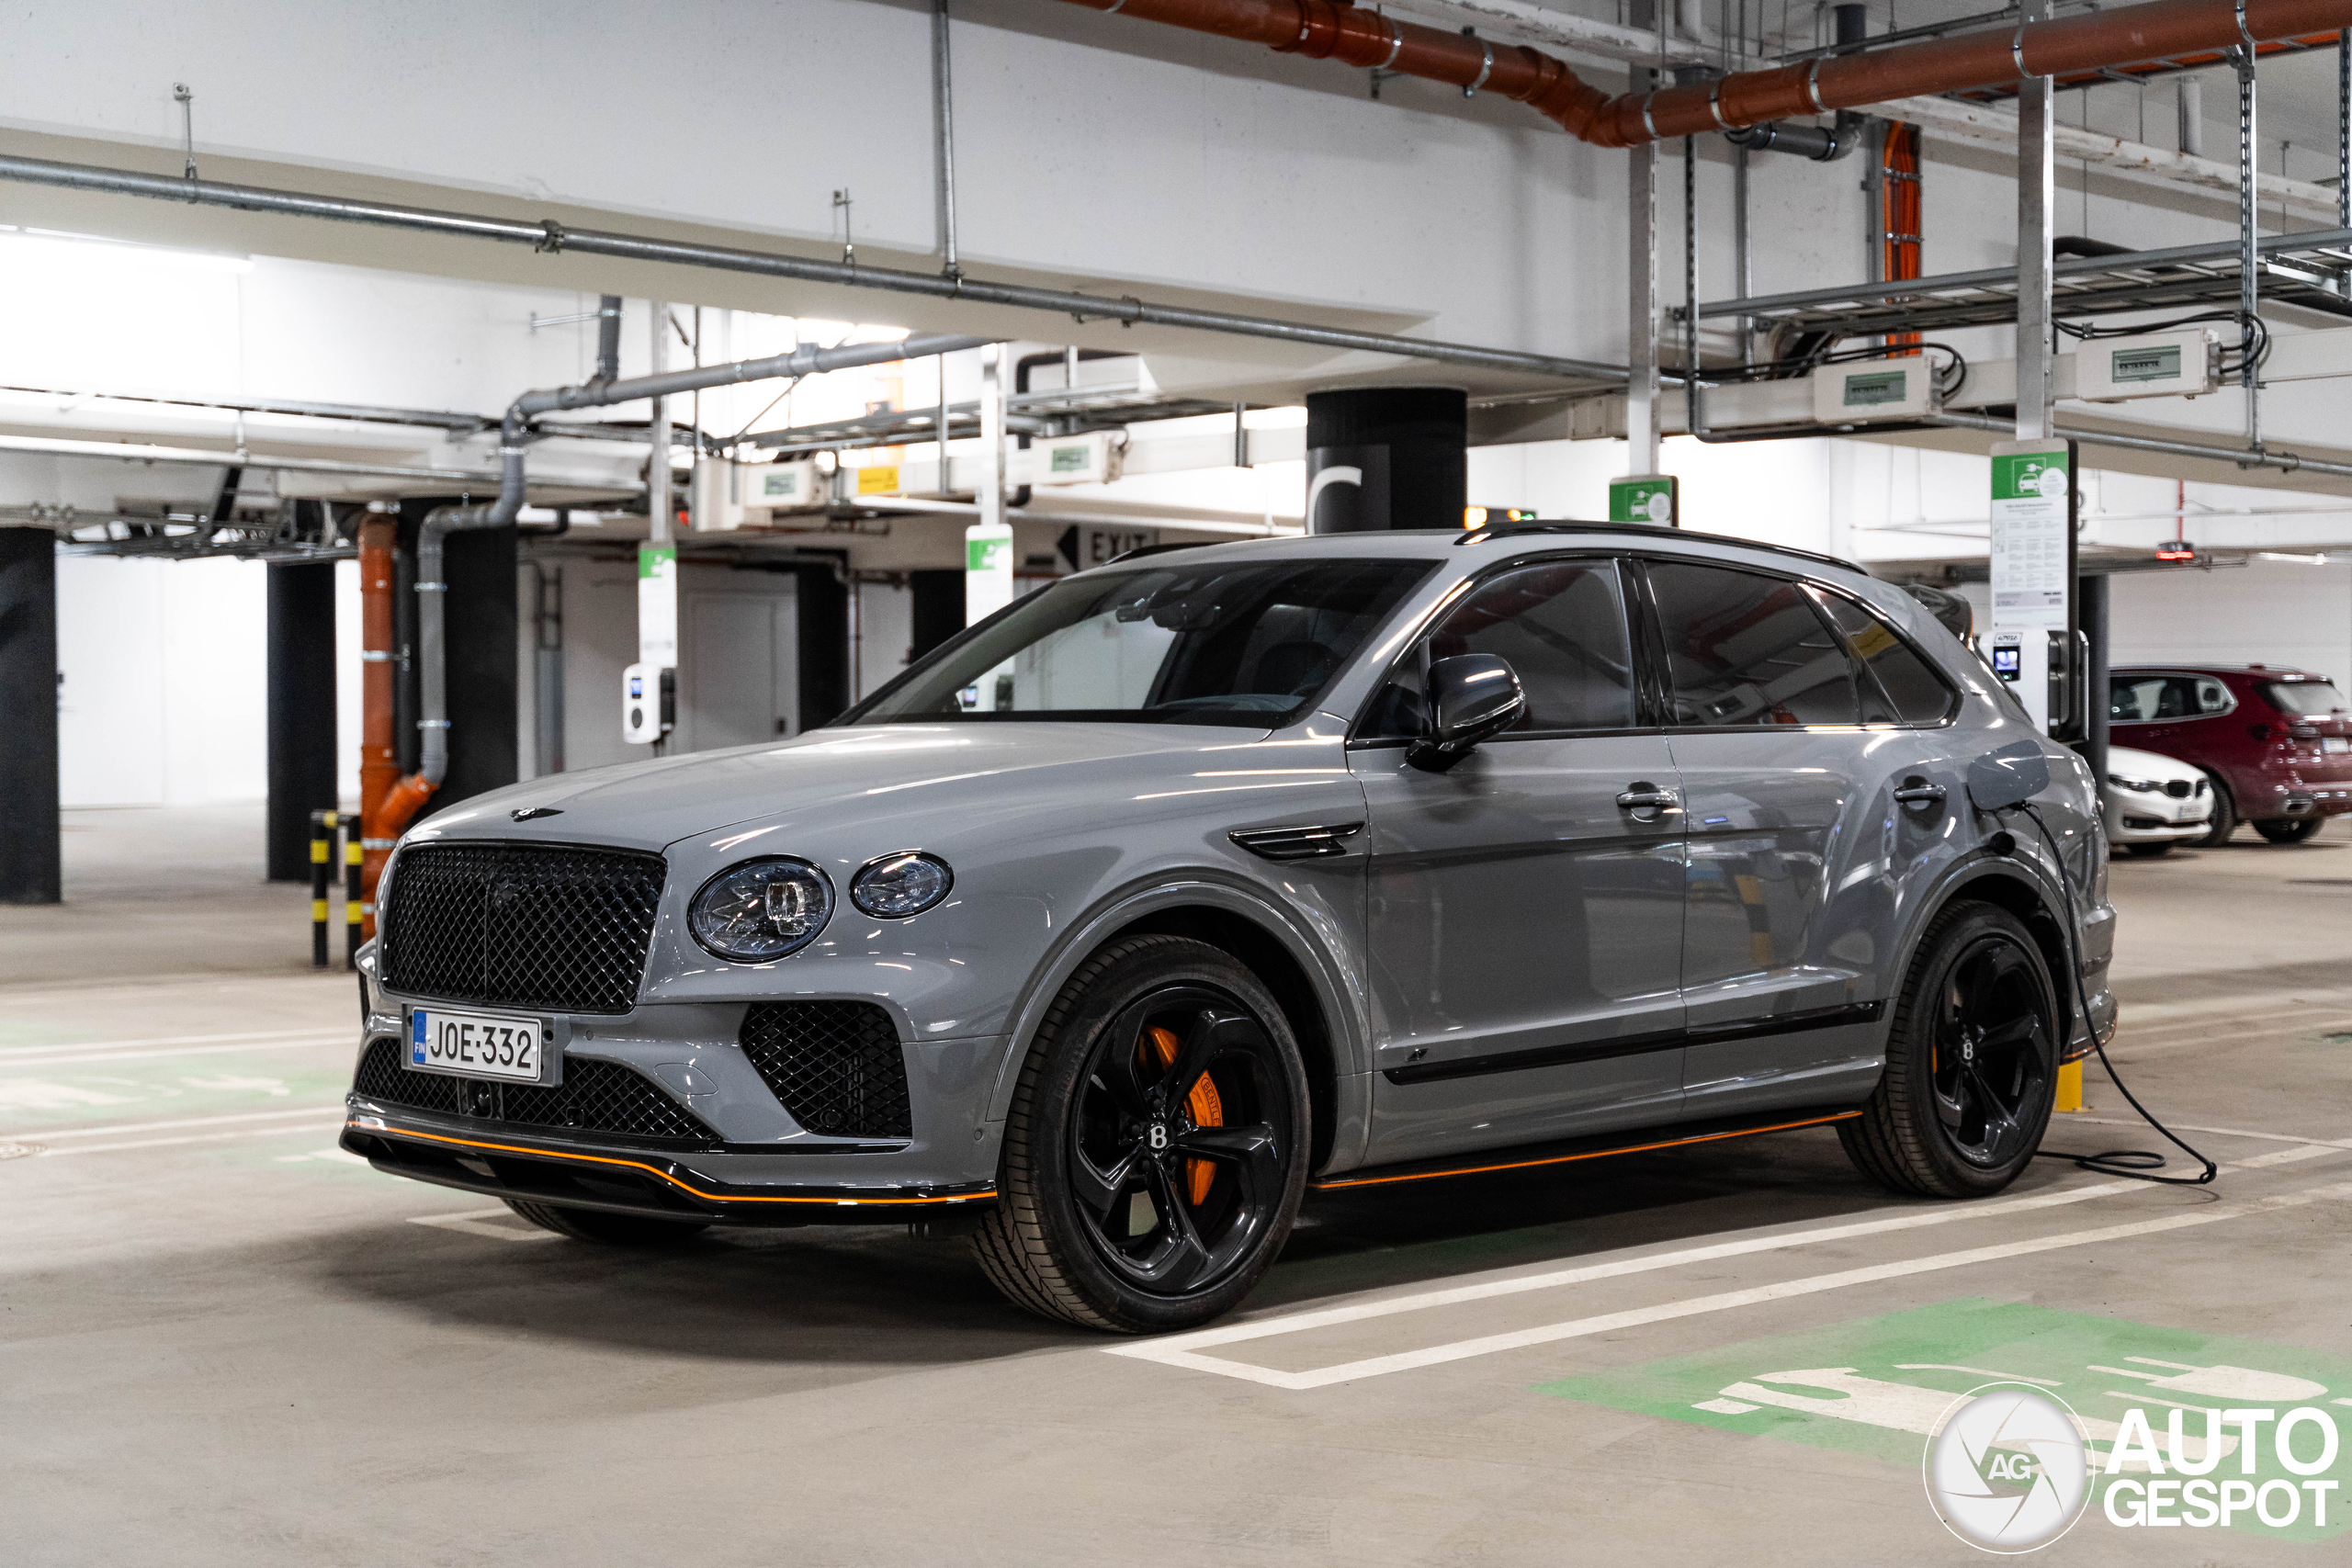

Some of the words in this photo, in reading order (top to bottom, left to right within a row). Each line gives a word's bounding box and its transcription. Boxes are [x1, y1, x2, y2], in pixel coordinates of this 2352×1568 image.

[1091, 532, 1147, 561] EXIT
[414, 1041, 425, 1055] FIN
[430, 1021, 531, 1068] JOE-332
[1203, 1081, 1220, 1126] BENTLE
[1149, 1124, 1168, 1149] B
